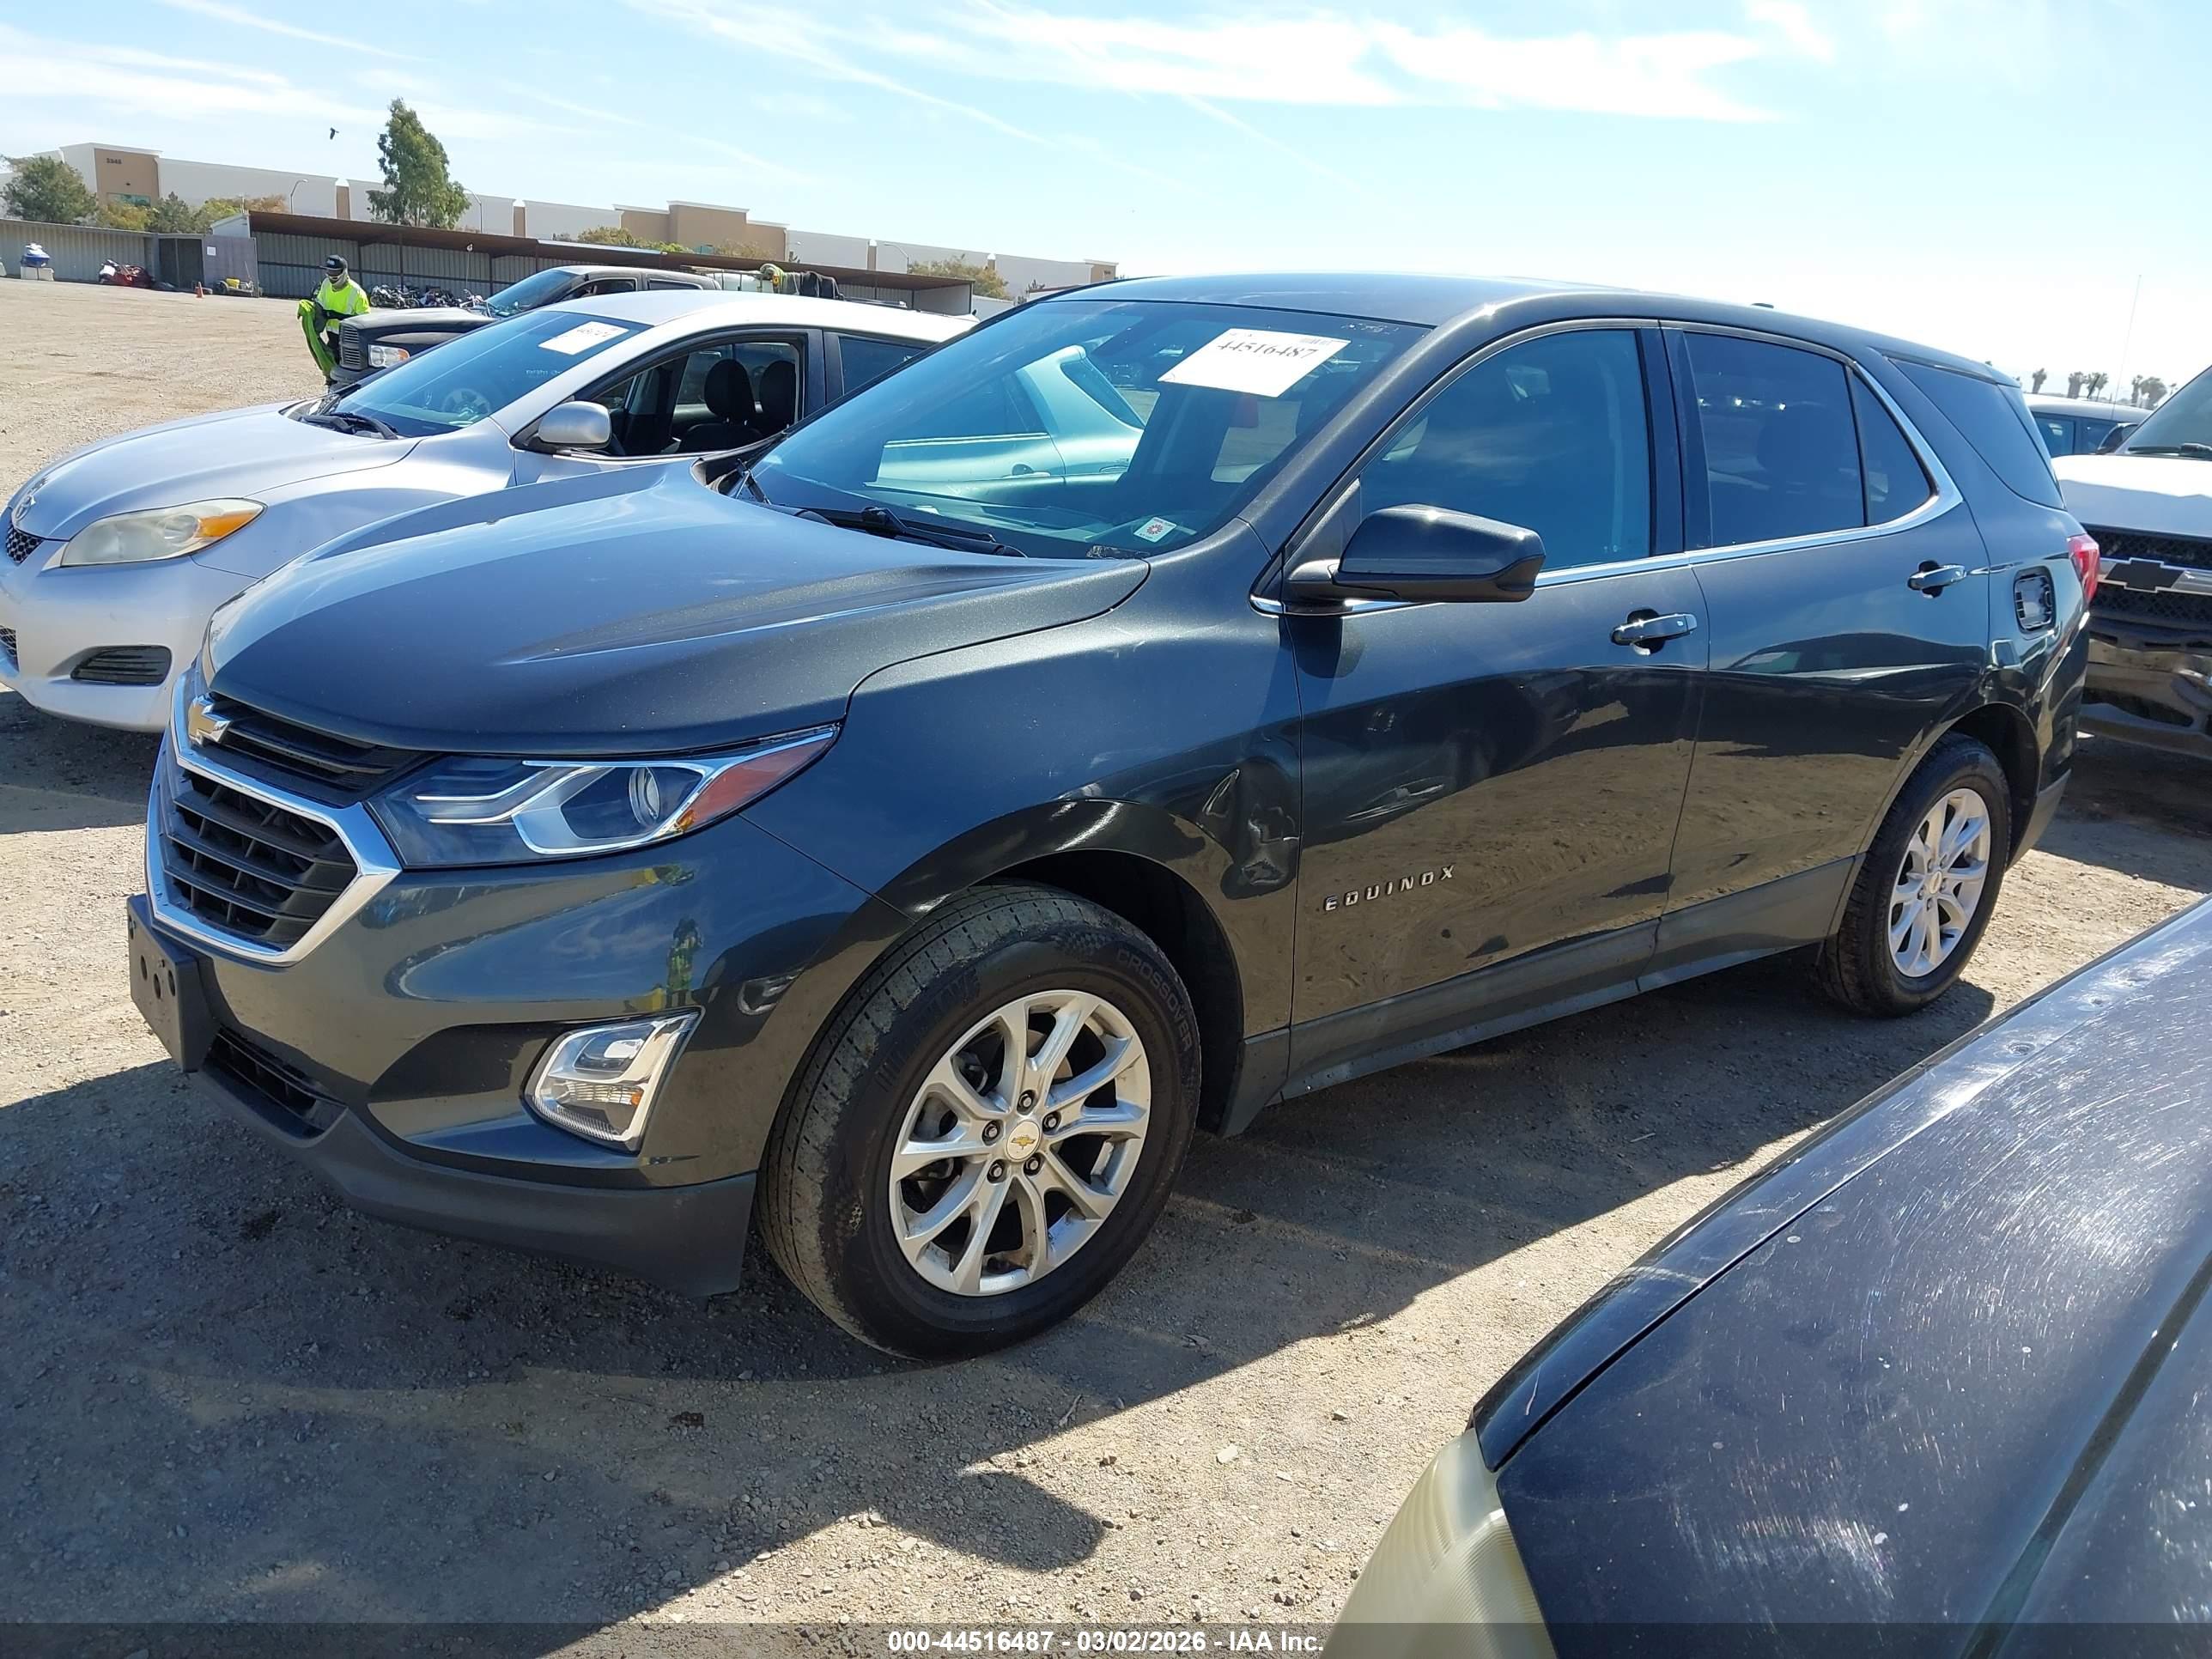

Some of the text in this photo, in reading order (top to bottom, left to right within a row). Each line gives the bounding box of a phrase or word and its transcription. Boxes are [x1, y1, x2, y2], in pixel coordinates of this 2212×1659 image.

[1218, 341, 1319, 359] 44516487
[1324, 865, 1455, 911] EQUINOX
[1115, 949, 1194, 1053] CROSSOVER
